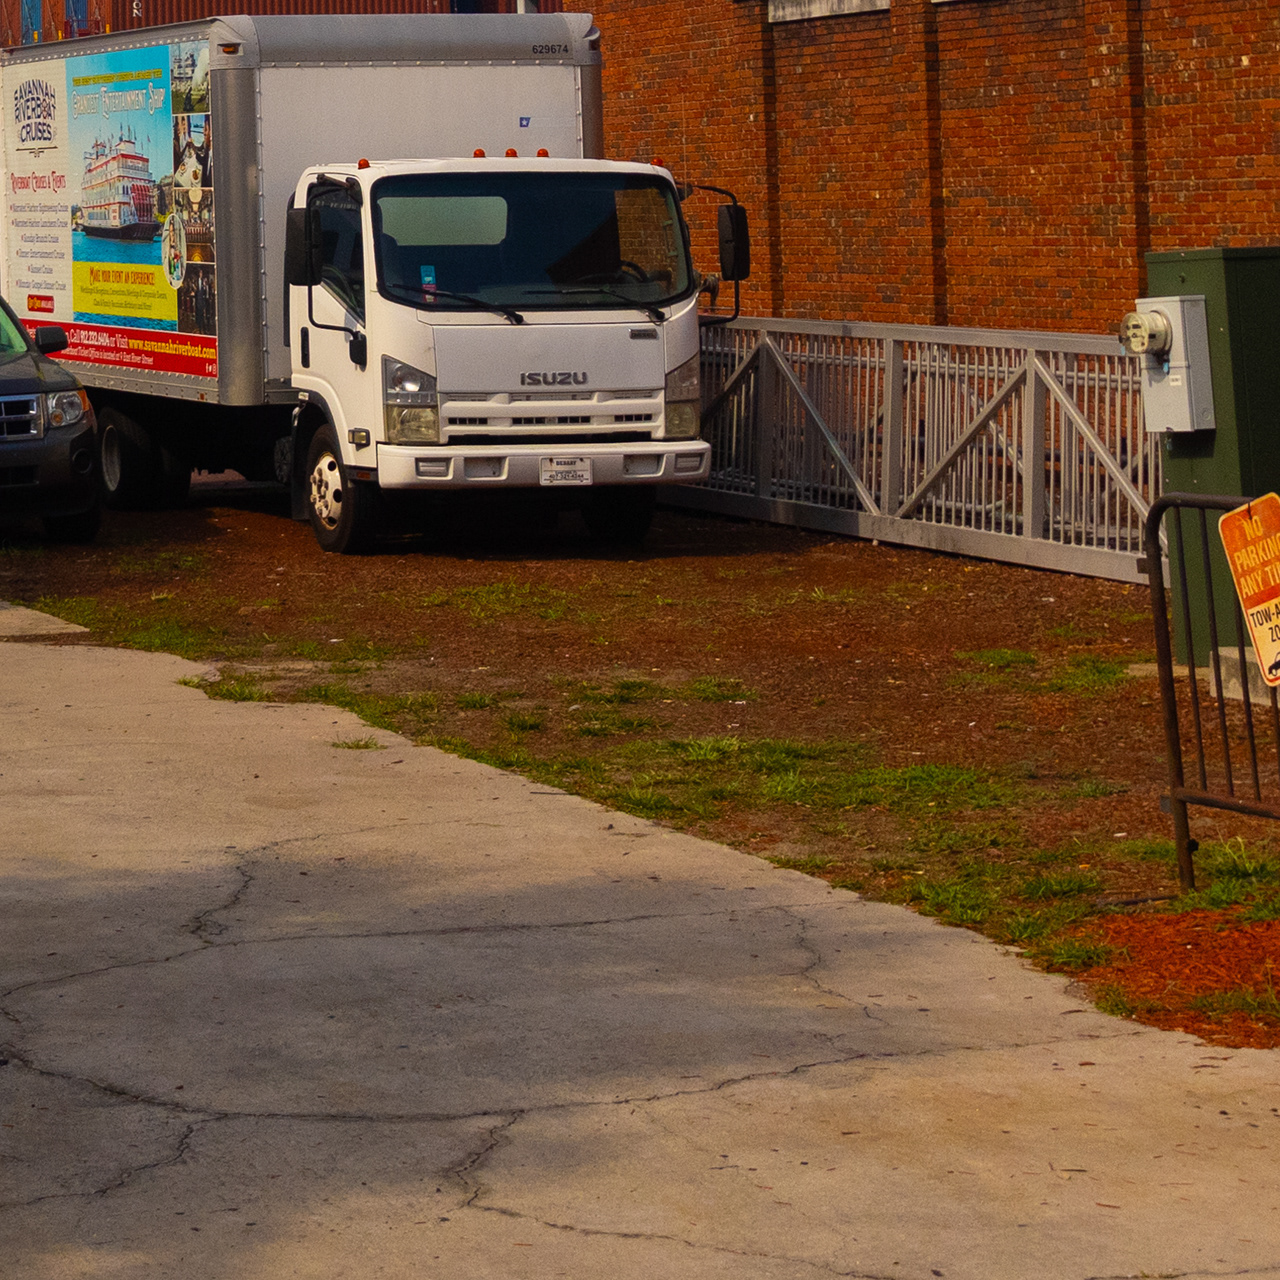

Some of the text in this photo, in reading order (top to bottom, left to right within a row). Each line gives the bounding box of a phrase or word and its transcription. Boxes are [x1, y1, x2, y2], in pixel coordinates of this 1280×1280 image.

[532, 44, 569, 54] 629674
[14, 79, 57, 104] SAVANNAH
[14, 96, 57, 125] RIVERBOAT
[20, 122, 53, 143] CRUISES
[128, 338, 217, 360] www.savannahriverboat.com
[520, 371, 588, 386] ISUZU
[1242, 515, 1263, 541] NO
[1241, 570, 1265, 599] ANY
[1250, 602, 1280, 629] TOW-A
